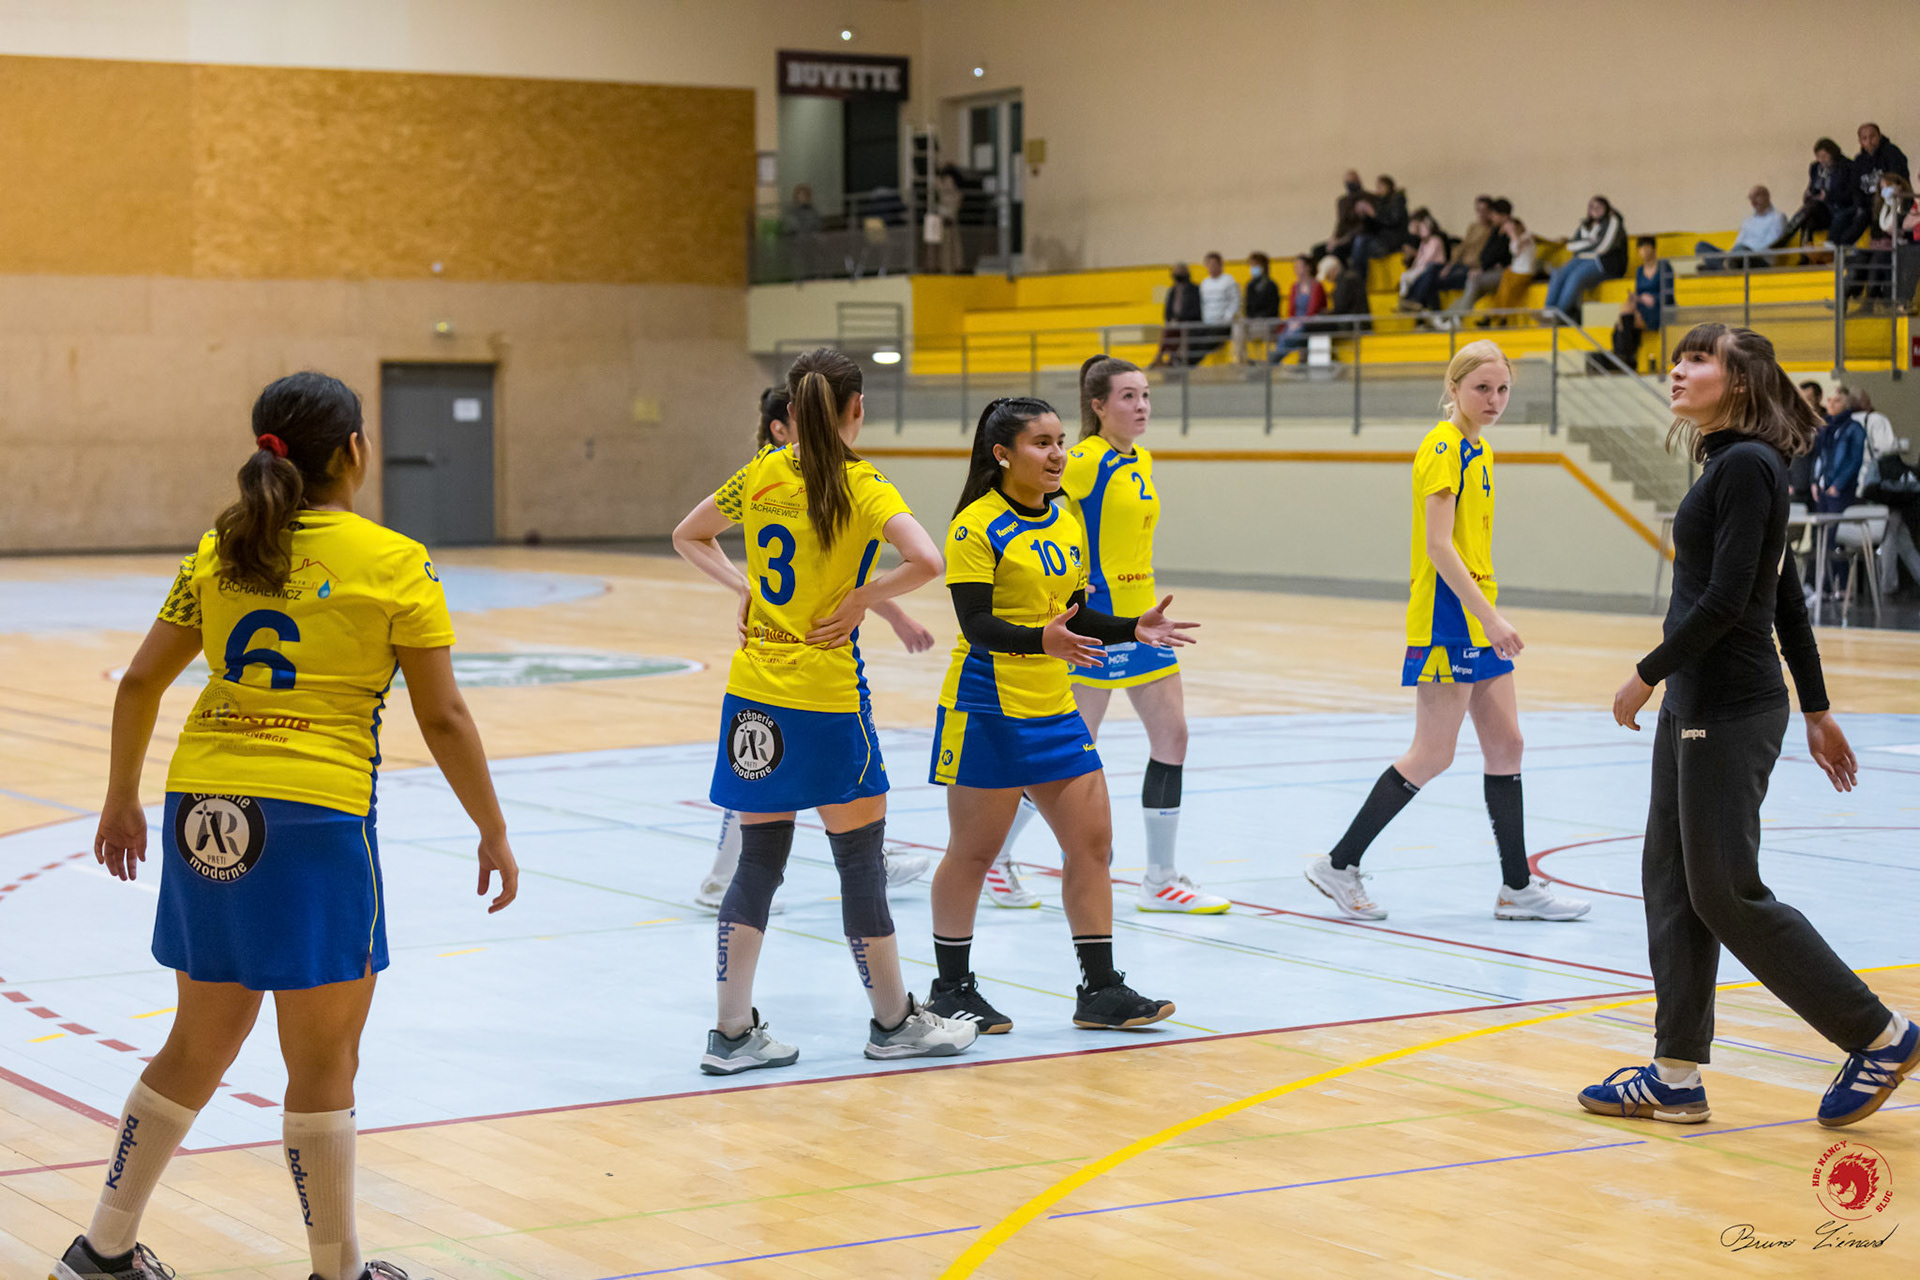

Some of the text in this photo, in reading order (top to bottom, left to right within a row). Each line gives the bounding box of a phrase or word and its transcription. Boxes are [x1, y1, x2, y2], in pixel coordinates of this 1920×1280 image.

[786, 61, 900, 92] BUVETTE
[1131, 472, 1153, 500] 2
[1483, 465, 1491, 497] 4
[757, 523, 797, 606] 3
[1030, 539, 1067, 577] 10
[223, 609, 300, 690] 6
[737, 710, 774, 728] Crêperie
[732, 761, 772, 780] moderne
[189, 855, 247, 881] moderne
[717, 921, 735, 982] Kemp
[850, 936, 873, 989] Kemp
[105, 1114, 140, 1190] Kempa
[288, 1148, 314, 1227] Kempa
